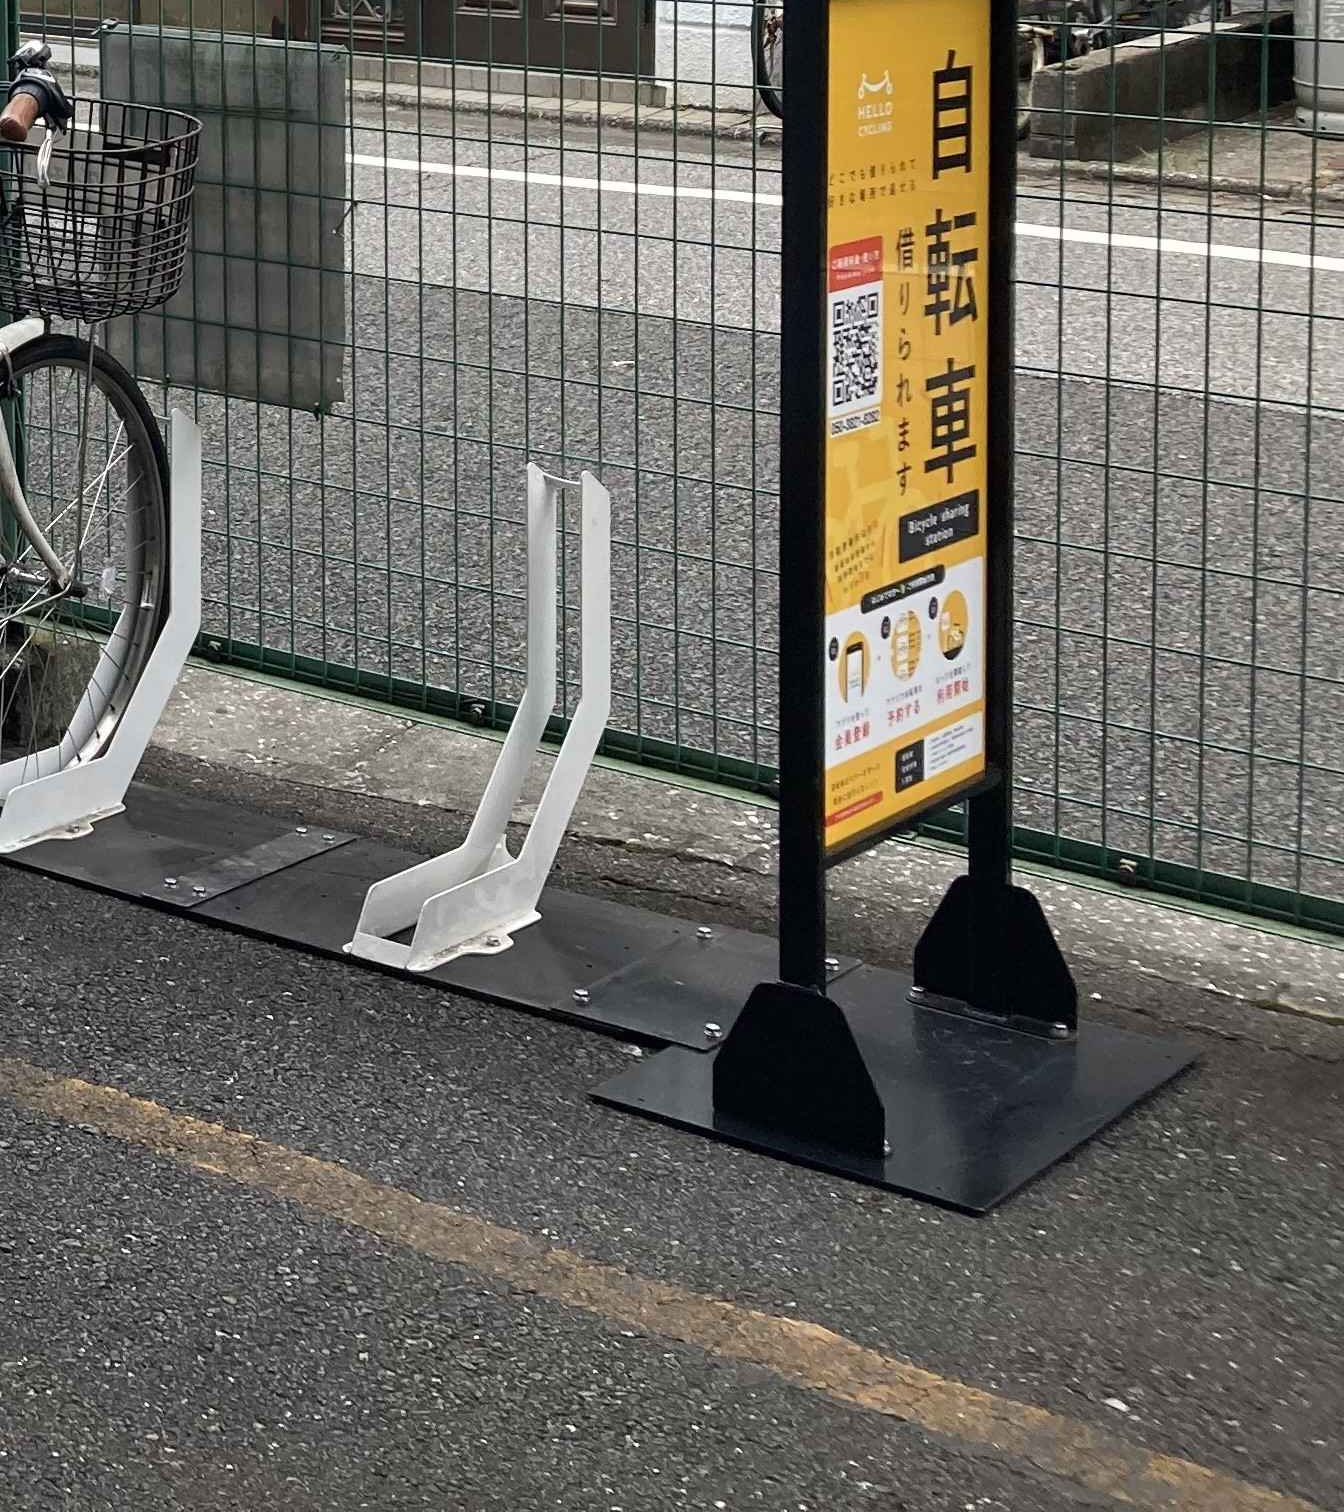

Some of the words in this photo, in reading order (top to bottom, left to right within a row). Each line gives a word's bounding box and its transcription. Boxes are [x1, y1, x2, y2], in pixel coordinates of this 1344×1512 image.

[857, 101, 893, 121] HELLO
[923, 49, 979, 486] 自転車
[895, 226, 917, 496] 借りられます
[907, 514, 938, 535] Bicycle
[941, 502, 971, 522] sharing
[924, 527, 955, 547] station
